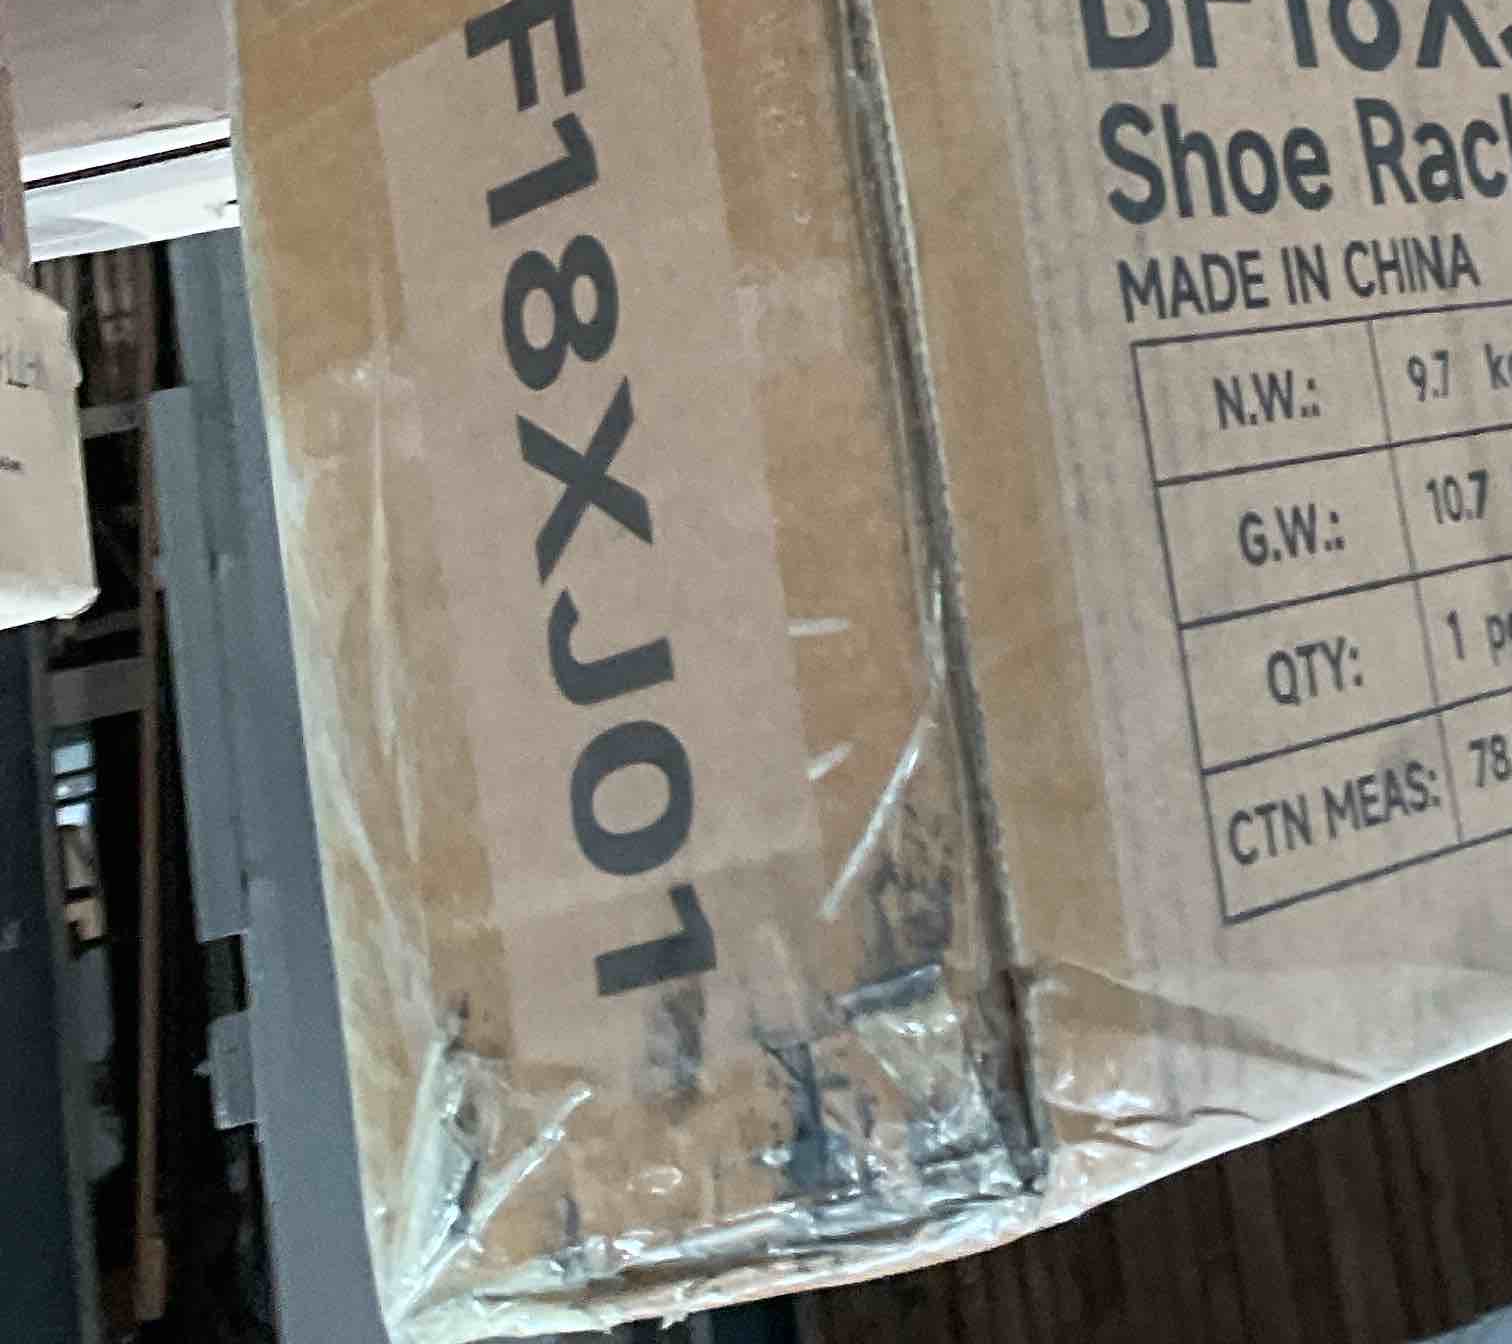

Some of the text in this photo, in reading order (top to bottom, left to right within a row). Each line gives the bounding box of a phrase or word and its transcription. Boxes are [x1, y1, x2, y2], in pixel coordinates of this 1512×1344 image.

[1099, 101, 1334, 225] Shoe
[1118, 233, 1482, 323] MADE IN CHINA
[1213, 368, 1322, 430] N.W.:
[1406, 350, 1452, 402] 9.7
[1238, 503, 1346, 566] G.W.:
[1425, 470, 1490, 525] 10.7
[1266, 637, 1365, 707] QTY:
[1446, 611, 1464, 660] 1
[1226, 792, 1313, 867] CTN
[1321, 762, 1442, 843] MEAS:
